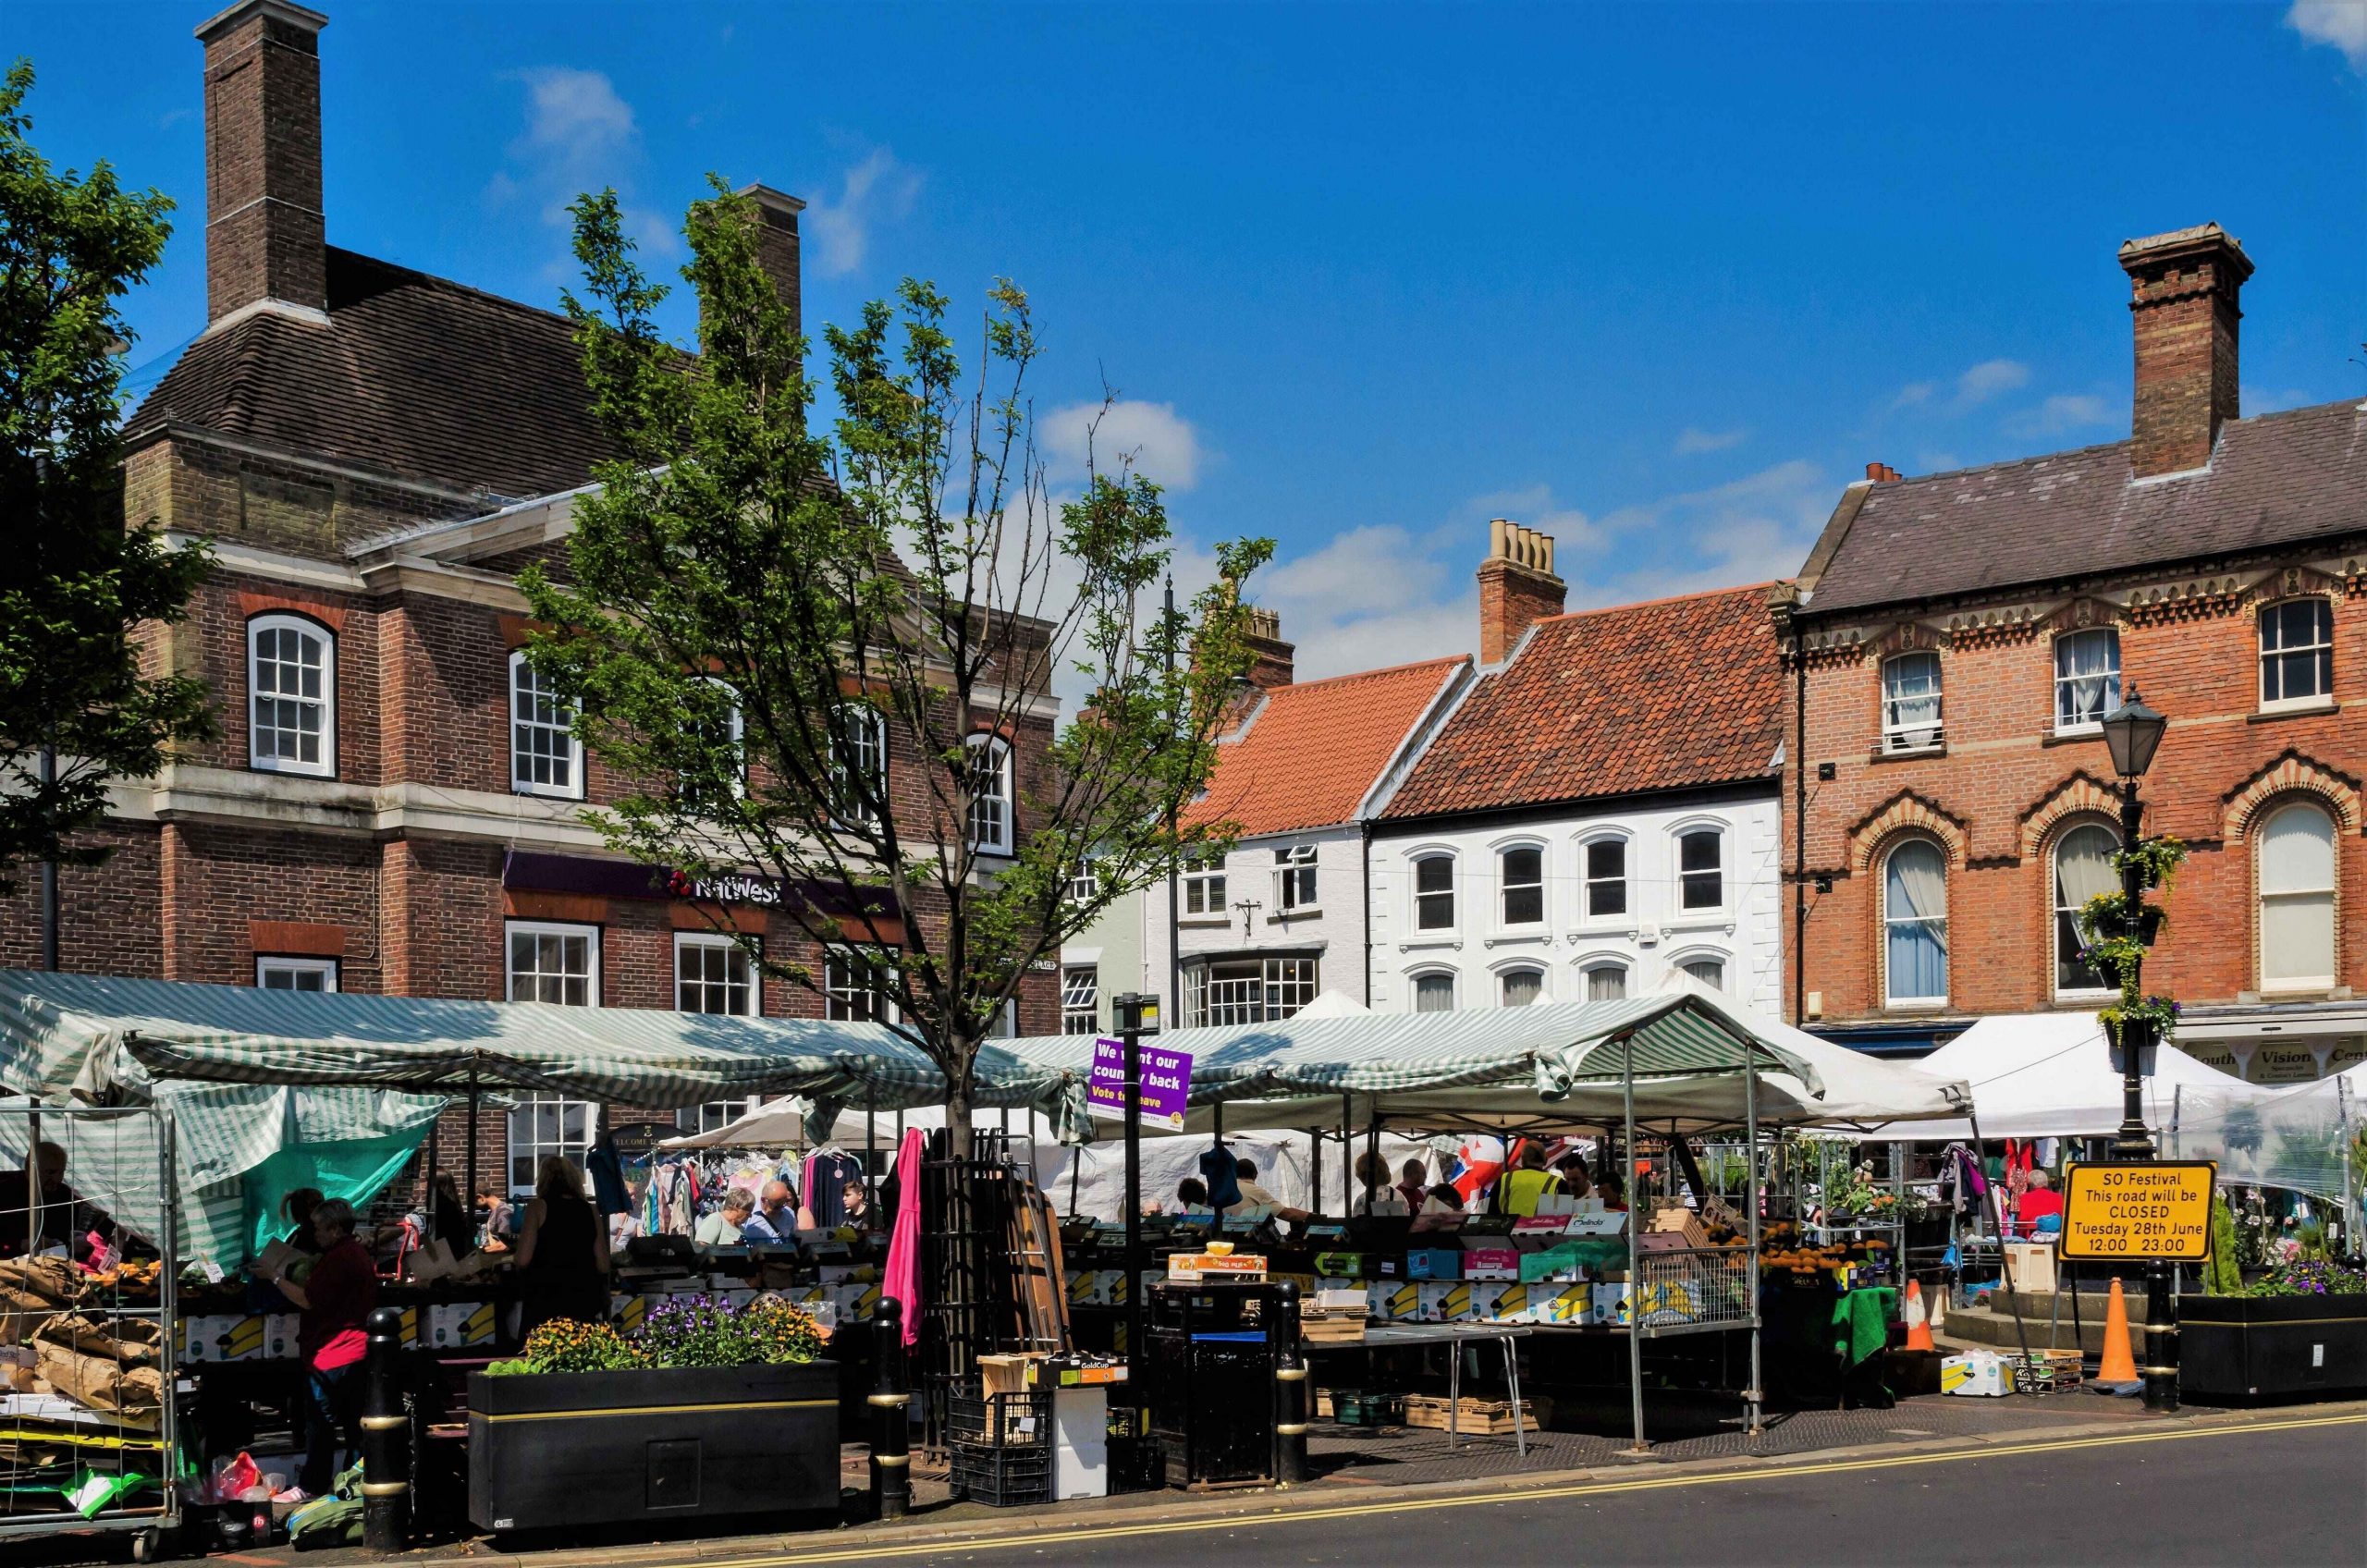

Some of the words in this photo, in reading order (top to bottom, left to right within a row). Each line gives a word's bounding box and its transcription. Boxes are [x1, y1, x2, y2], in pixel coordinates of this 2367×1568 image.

[695, 876, 781, 903] NatWest
[1098, 1043, 1116, 1059] We
[1156, 1056, 1180, 1070] our
[2262, 1050, 2312, 1063] Vision
[2332, 1048, 2367, 1061] Cen
[1095, 1065, 1146, 1085] couny
[1149, 1072, 1180, 1090] back
[1092, 1085, 1114, 1100] Vote
[1139, 1095, 1161, 1109] eave
[2103, 1173, 2123, 1185] SO
[2129, 1172, 2181, 1185] Festival
[2086, 1189, 2112, 1202] This
[2116, 1190, 2146, 1202] road
[2152, 1189, 2176, 1202] will
[2181, 1189, 2197, 1201] be
[2109, 1206, 2169, 1219] CLOSED
[2075, 1222, 2128, 1237] Tuesday
[2134, 1222, 2166, 1235] 28th
[2172, 1222, 2202, 1235] June
[2089, 1239, 2127, 1252] 12:00
[2141, 1239, 2185, 1252] 23:00
[1081, 1362, 1109, 1370] GoldCup
